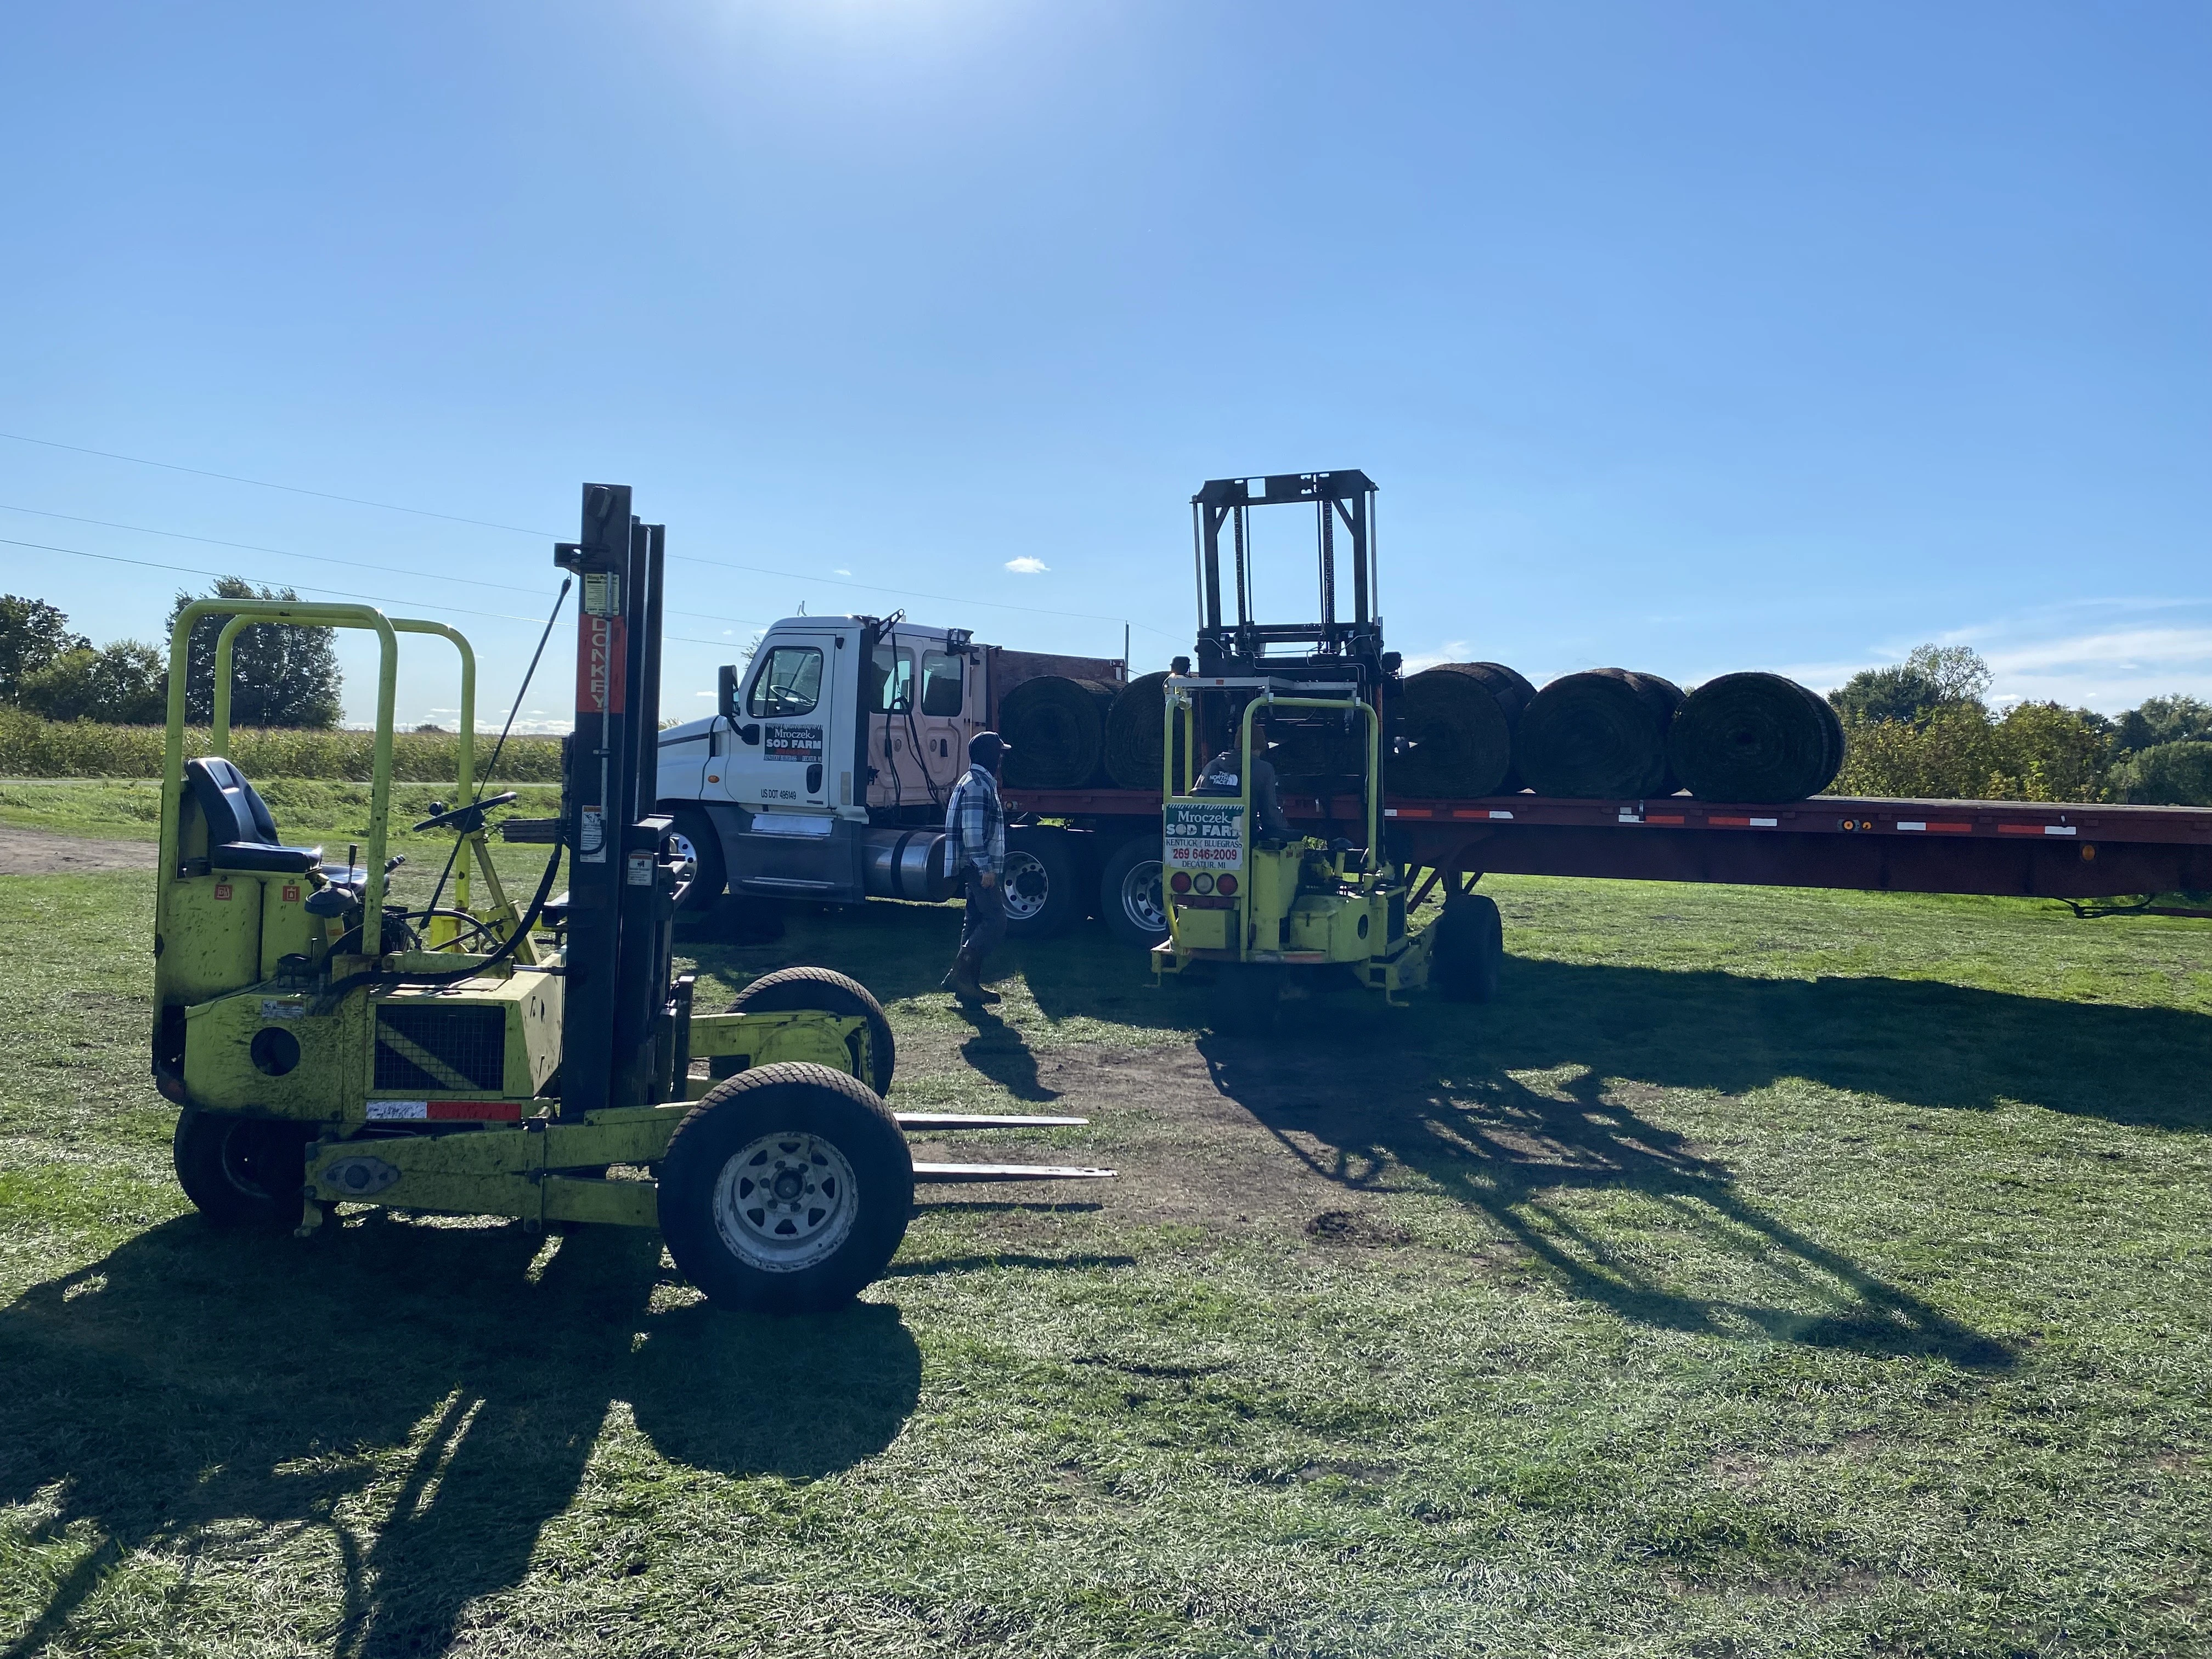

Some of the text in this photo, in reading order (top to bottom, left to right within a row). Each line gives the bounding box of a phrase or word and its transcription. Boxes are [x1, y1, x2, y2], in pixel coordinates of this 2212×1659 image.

[591, 618, 607, 708] DONKEY
[775, 729, 815, 739] Mroczek
[766, 738, 821, 749] SOD FARM
[761, 789, 797, 800] US DOT 495149
[1178, 811, 1232, 823] Mroczek
[1166, 823, 1198, 836] SOD
[1166, 839, 1243, 848] KENTUCK BLUEGRASS
[1173, 848, 1237, 860] 269 646-2009
